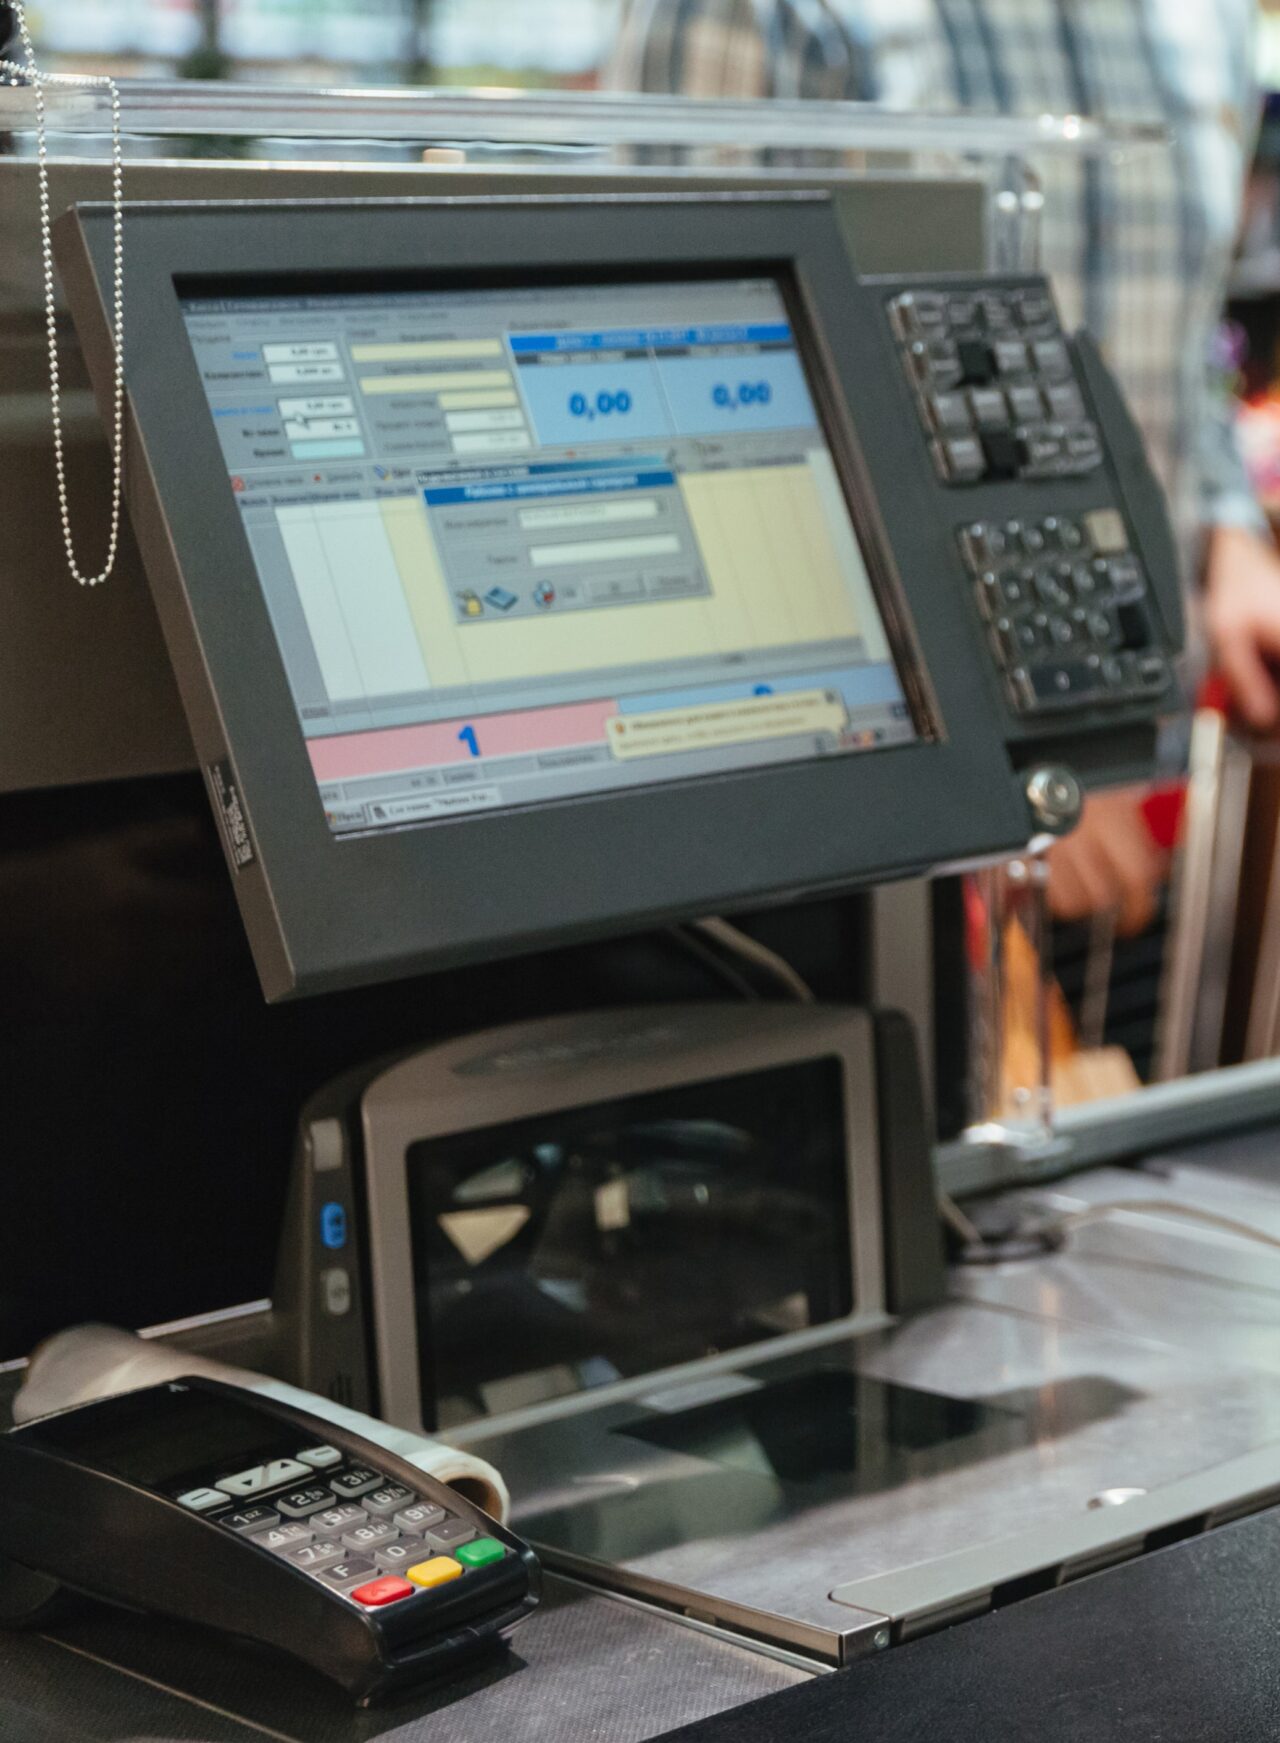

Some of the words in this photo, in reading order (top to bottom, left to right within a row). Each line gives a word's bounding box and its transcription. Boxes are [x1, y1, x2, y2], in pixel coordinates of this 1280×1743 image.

[713, 381, 772, 410] 0,00
[569, 390, 632, 420] 0,00
[457, 725, 481, 758] 1
[343, 1474, 362, 1485] 3
[290, 1494, 311, 1505] 2
[373, 1492, 392, 1503] 6
[233, 1514, 250, 1524] 1
[323, 1511, 342, 1522] 5
[405, 1509, 424, 1520] 9
[268, 1531, 285, 1542] 4
[355, 1528, 375, 1539] 8
[297, 1547, 315, 1559] 7
[333, 1564, 349, 1577] F
